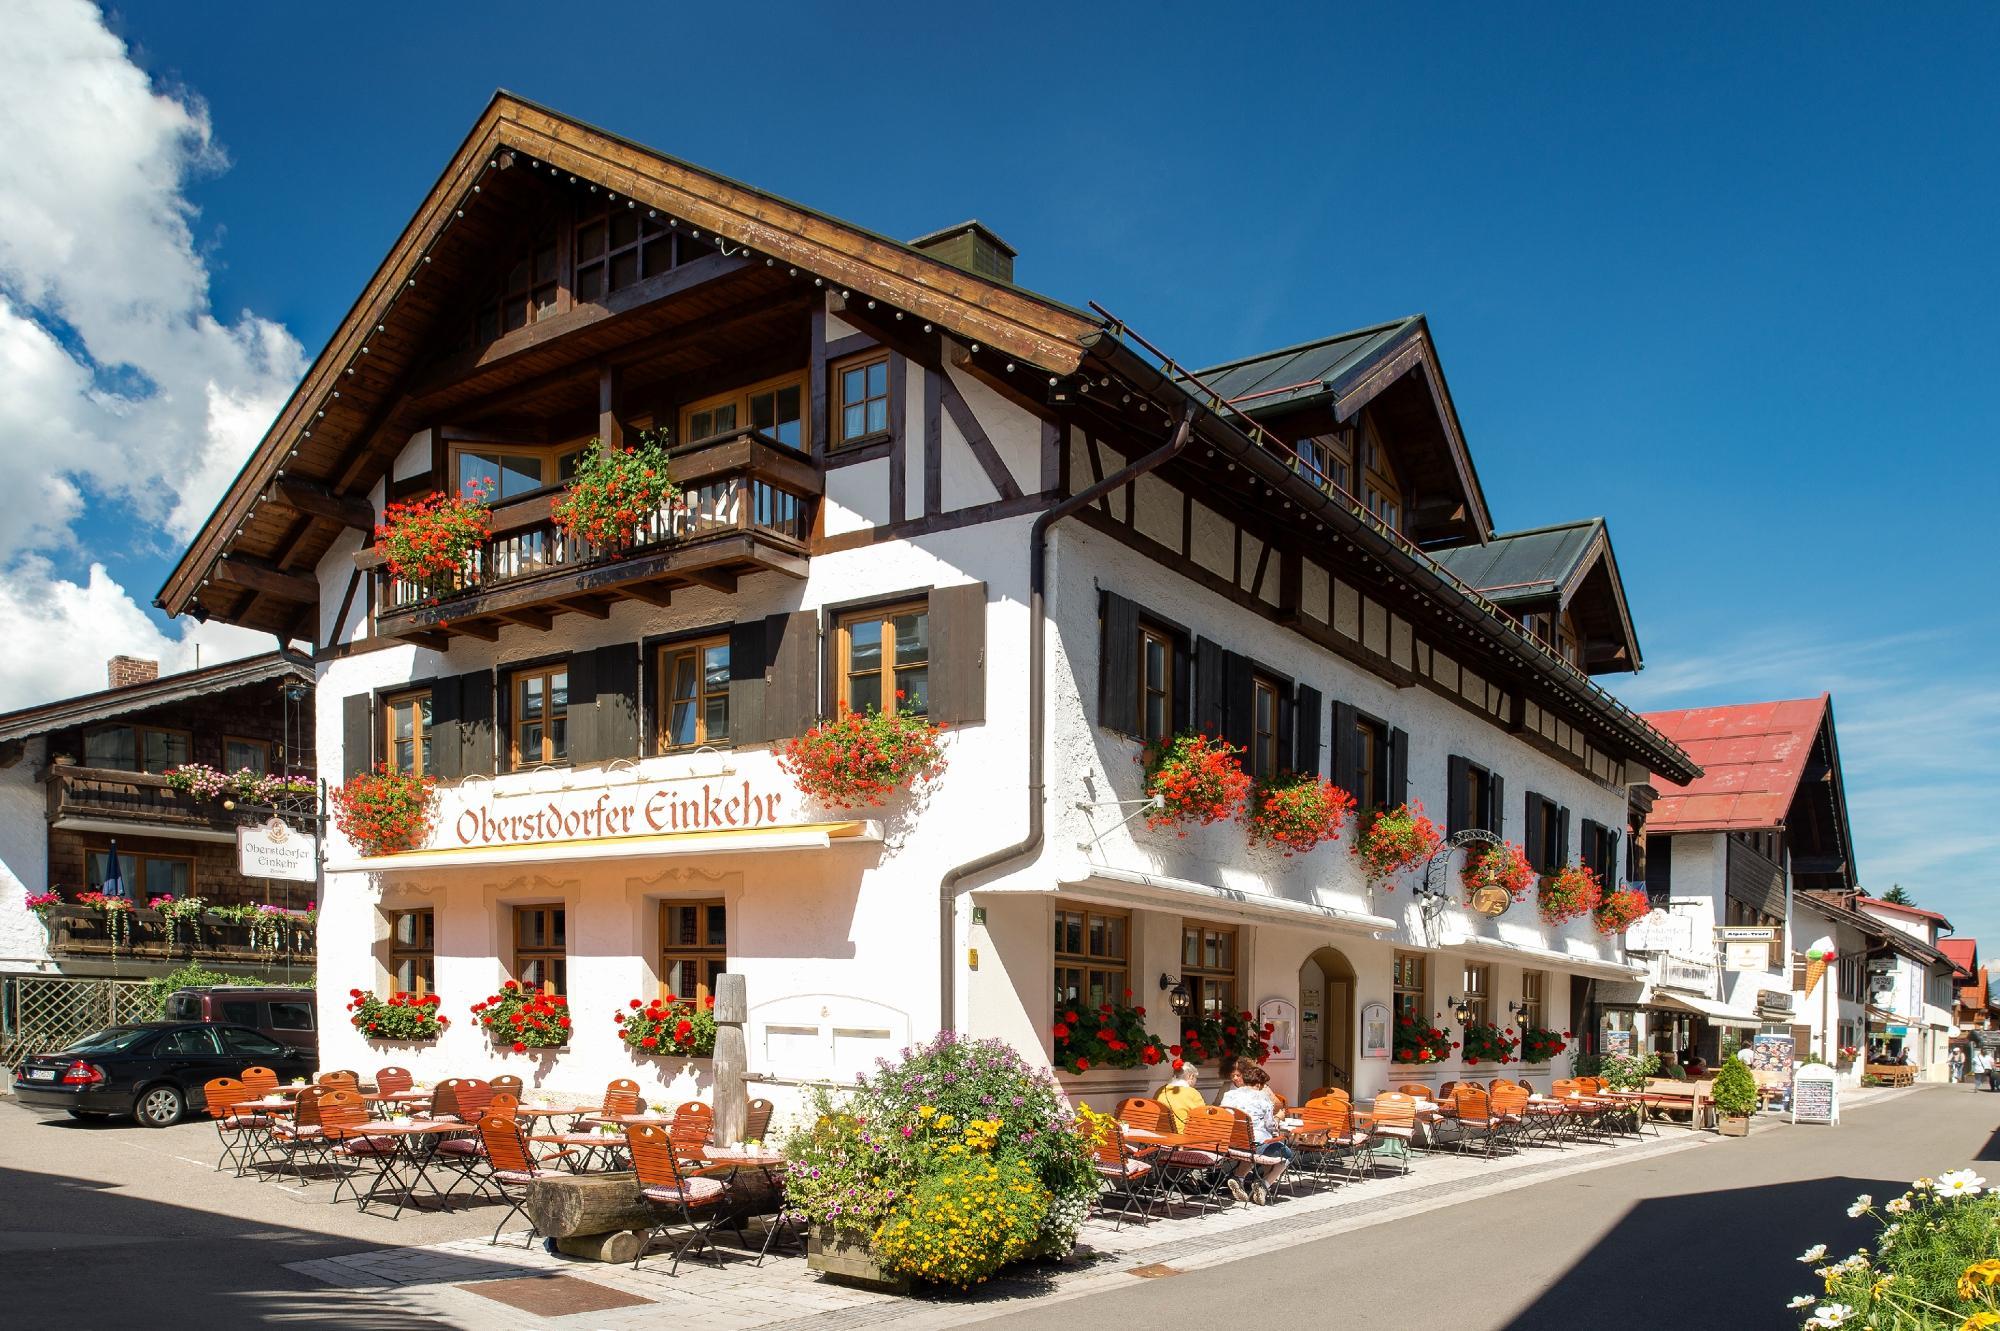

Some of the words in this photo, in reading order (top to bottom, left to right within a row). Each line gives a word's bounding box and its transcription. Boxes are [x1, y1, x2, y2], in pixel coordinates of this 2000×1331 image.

[456, 793, 635, 845] Oberstdorfer
[645, 780, 782, 832] Einkehr
[246, 843, 309, 859] Oberstdorfer
[258, 856, 298, 869] Einkehr
